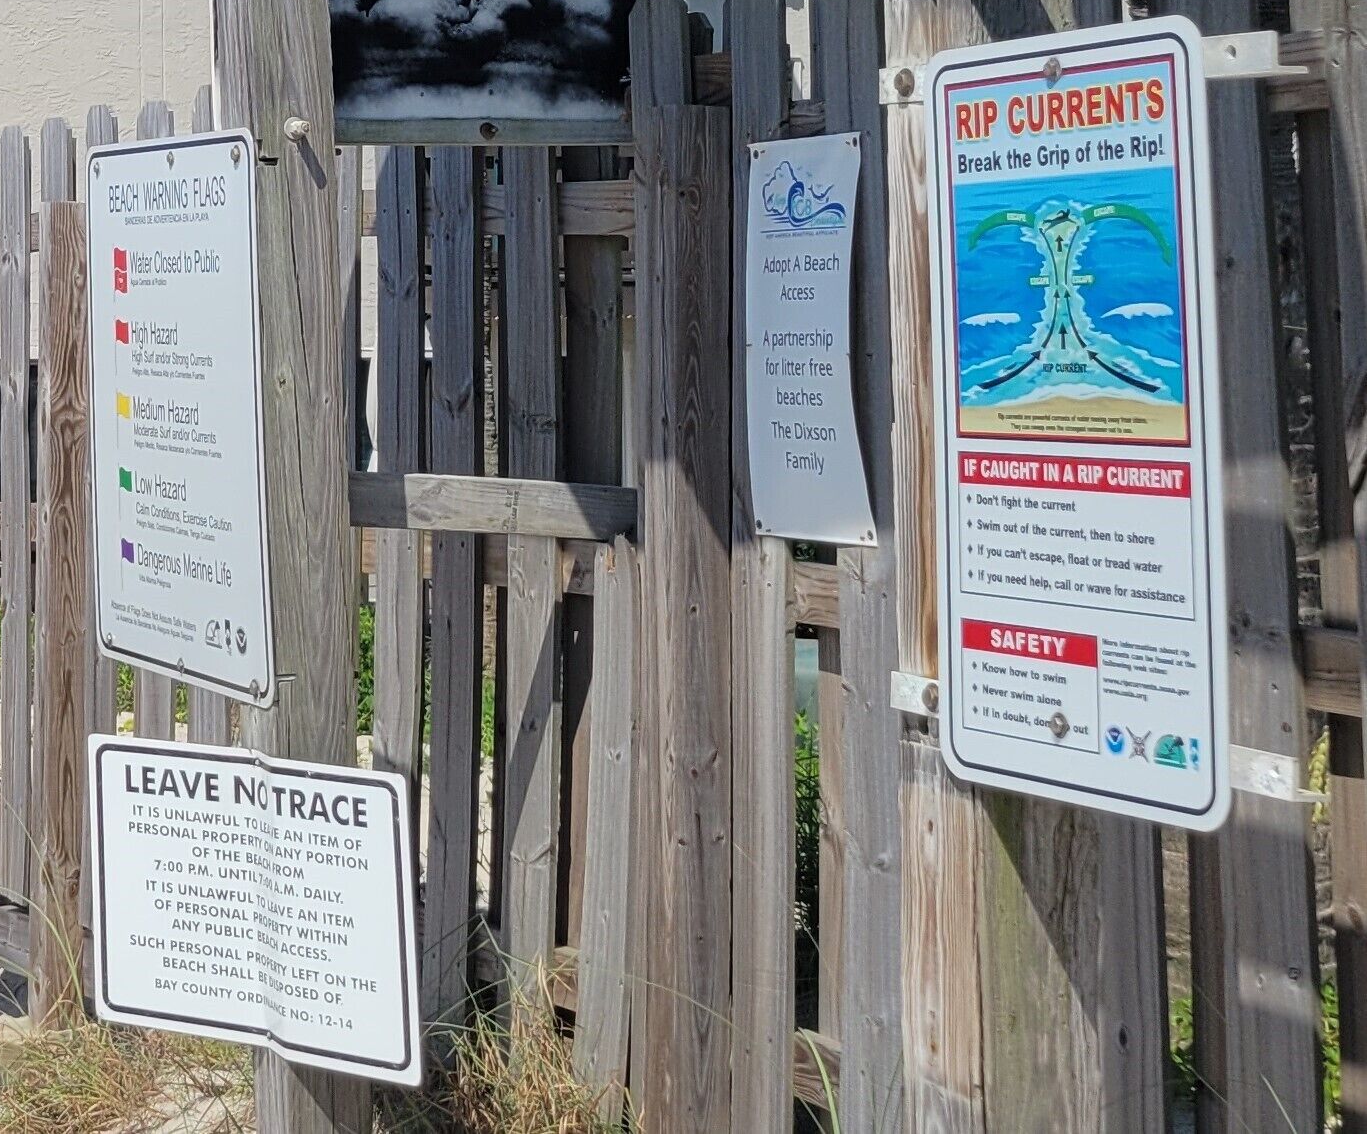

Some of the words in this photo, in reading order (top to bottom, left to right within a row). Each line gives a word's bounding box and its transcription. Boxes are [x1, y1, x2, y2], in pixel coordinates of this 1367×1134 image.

[956, 100, 999, 141] RIP
[1007, 78, 1165, 135] CURRENTS
[958, 152, 1001, 174] Break
[1006, 150, 1032, 169] the
[1037, 145, 1069, 169] Grip
[1075, 141, 1091, 161] of
[1097, 139, 1124, 161] the
[1130, 134, 1165, 163] Rip!
[109, 184, 138, 213] BEACH
[143, 179, 188, 211] WARNING
[193, 176, 226, 208] FLAGS
[130, 251, 152, 274] Water
[154, 250, 181, 274] Closed
[184, 251, 191, 273] to
[194, 249, 220, 273] Public
[763, 255, 791, 278] Adopt
[793, 255, 800, 272] A
[804, 253, 840, 271] Beach
[781, 284, 815, 301] Access
[132, 321, 148, 349] High
[152, 322, 178, 345] Hazard
[763, 330, 770, 347] A
[772, 329, 833, 352] partnership
[132, 350, 142, 365] High
[144, 351, 153, 364] Surf
[172, 352, 189, 368] Strong
[766, 357, 779, 376] for
[782, 357, 806, 376] litter
[809, 358, 833, 376] free
[133, 396, 165, 422] Medium
[168, 399, 199, 425] Hazard
[777, 387, 823, 406] beaches
[134, 424, 158, 438] Moderate
[160, 426, 171, 438] Surf
[771, 421, 791, 439] The
[794, 422, 836, 442] Dixson
[786, 451, 824, 475] Family
[964, 458, 977, 477] IF
[980, 460, 1040, 481] CAUGHT
[1043, 463, 1060, 482] IN
[1063, 464, 1074, 482] A
[1077, 464, 1103, 484] RIP
[1107, 466, 1184, 489] CURRENT
[135, 471, 152, 495] Low
[155, 474, 186, 502] Hazard
[136, 502, 150, 515] Calm
[208, 515, 232, 531] Caution
[976, 494, 998, 506] Don't
[1001, 496, 1021, 510] fight
[1024, 497, 1038, 509] the
[1042, 501, 1076, 512] current
[977, 519, 1000, 532] Swim
[1003, 522, 1018, 533] out
[1020, 523, 1029, 534] of
[1032, 523, 1046, 535] the
[1050, 527, 1087, 541] current,
[1090, 528, 1111, 541] then
[1114, 531, 1124, 542] to
[1127, 532, 1155, 545] shore
[138, 543, 181, 575] Dangerous
[183, 552, 212, 582] Marine
[215, 559, 232, 587] Life
[977, 544, 984, 555] If
[986, 548, 1001, 559] you
[1004, 548, 1027, 560] can't
[1029, 551, 1065, 565] escape,
[1068, 553, 1089, 566] float
[1092, 558, 1102, 567] or
[1105, 557, 1130, 570] tread
[1133, 562, 1163, 573] water
[978, 570, 984, 581] If
[987, 574, 1002, 584] you
[1005, 574, 1027, 585] need
[1030, 575, 1051, 590] help,
[1054, 579, 1071, 590] call
[1074, 582, 1084, 591] or
[1087, 584, 1111, 595] wave
[1114, 584, 1127, 597] for
[1130, 588, 1185, 603] assistance
[990, 628, 1066, 656] SAFETY
[981, 662, 1006, 674] Know
[1010, 666, 1028, 678] how
[1031, 670, 1039, 680] to
[1042, 673, 1066, 684] swim
[982, 684, 1008, 697] Never
[1010, 690, 1034, 702] swim
[1037, 694, 1062, 706] alone
[982, 707, 989, 717] If
[992, 708, 1000, 718] in
[1002, 710, 1031, 726] doubt,
[1073, 725, 1088, 735] out
[125, 764, 220, 802] LEAVE
[234, 774, 269, 811] NO
[272, 787, 368, 828] TRACE
[132, 804, 144, 816] IT
[148, 806, 160, 817] IS
[164, 807, 240, 827] UNLAWFUL
[244, 817, 258, 830] TO
[284, 829, 303, 842] AN
[308, 833, 339, 848] ITEM
[344, 838, 362, 851] OF
[128, 822, 198, 840] PERSONAL
[202, 830, 262, 849] PROPERTY
[275, 847, 302, 861] ANY
[306, 851, 369, 870] PORTION
[192, 847, 210, 858] OF
[214, 849, 241, 862] THE
[246, 852, 272, 869] BEACH
[272, 863, 304, 879] FROM
[154, 860, 183, 873] 7:00
[188, 864, 213, 877] P.M.
[218, 867, 257, 883] UNTIL
[274, 883, 299, 898] A.M.
[303, 887, 344, 905] DAILY.
[145, 879, 158, 891] IT
[161, 881, 174, 894] IS
[178, 883, 254, 904] UNLAWFUL
[256, 894, 266, 907] TO
[267, 901, 293, 918] LEAVE
[297, 908, 318, 922] AN
[323, 913, 355, 928] ITEM
[154, 899, 172, 910] OF
[177, 902, 248, 921] PERSONAL
[253, 912, 292, 936] PROPERTY
[296, 927, 348, 946] WITHIN
[171, 918, 201, 932] ANY
[205, 924, 253, 940] PUBLIC
[257, 931, 278, 951] BEACH
[280, 942, 332, 962] ACCESS.
[129, 935, 165, 950] SUCH
[170, 940, 242, 961] PERSONAL
[246, 951, 287, 976] PROPERTY
[291, 967, 319, 982] LEFT
[324, 974, 347, 988] ON
[351, 978, 378, 993] THE
[162, 957, 206, 973] BEACH
[211, 964, 254, 981] SHALL
[269, 977, 319, 1000] DISPOSED
[155, 978, 177, 991] BAY
[182, 981, 233, 999] COUNTY
[290, 1008, 313, 1023] NO:
[319, 1014, 353, 1030] 12-14
